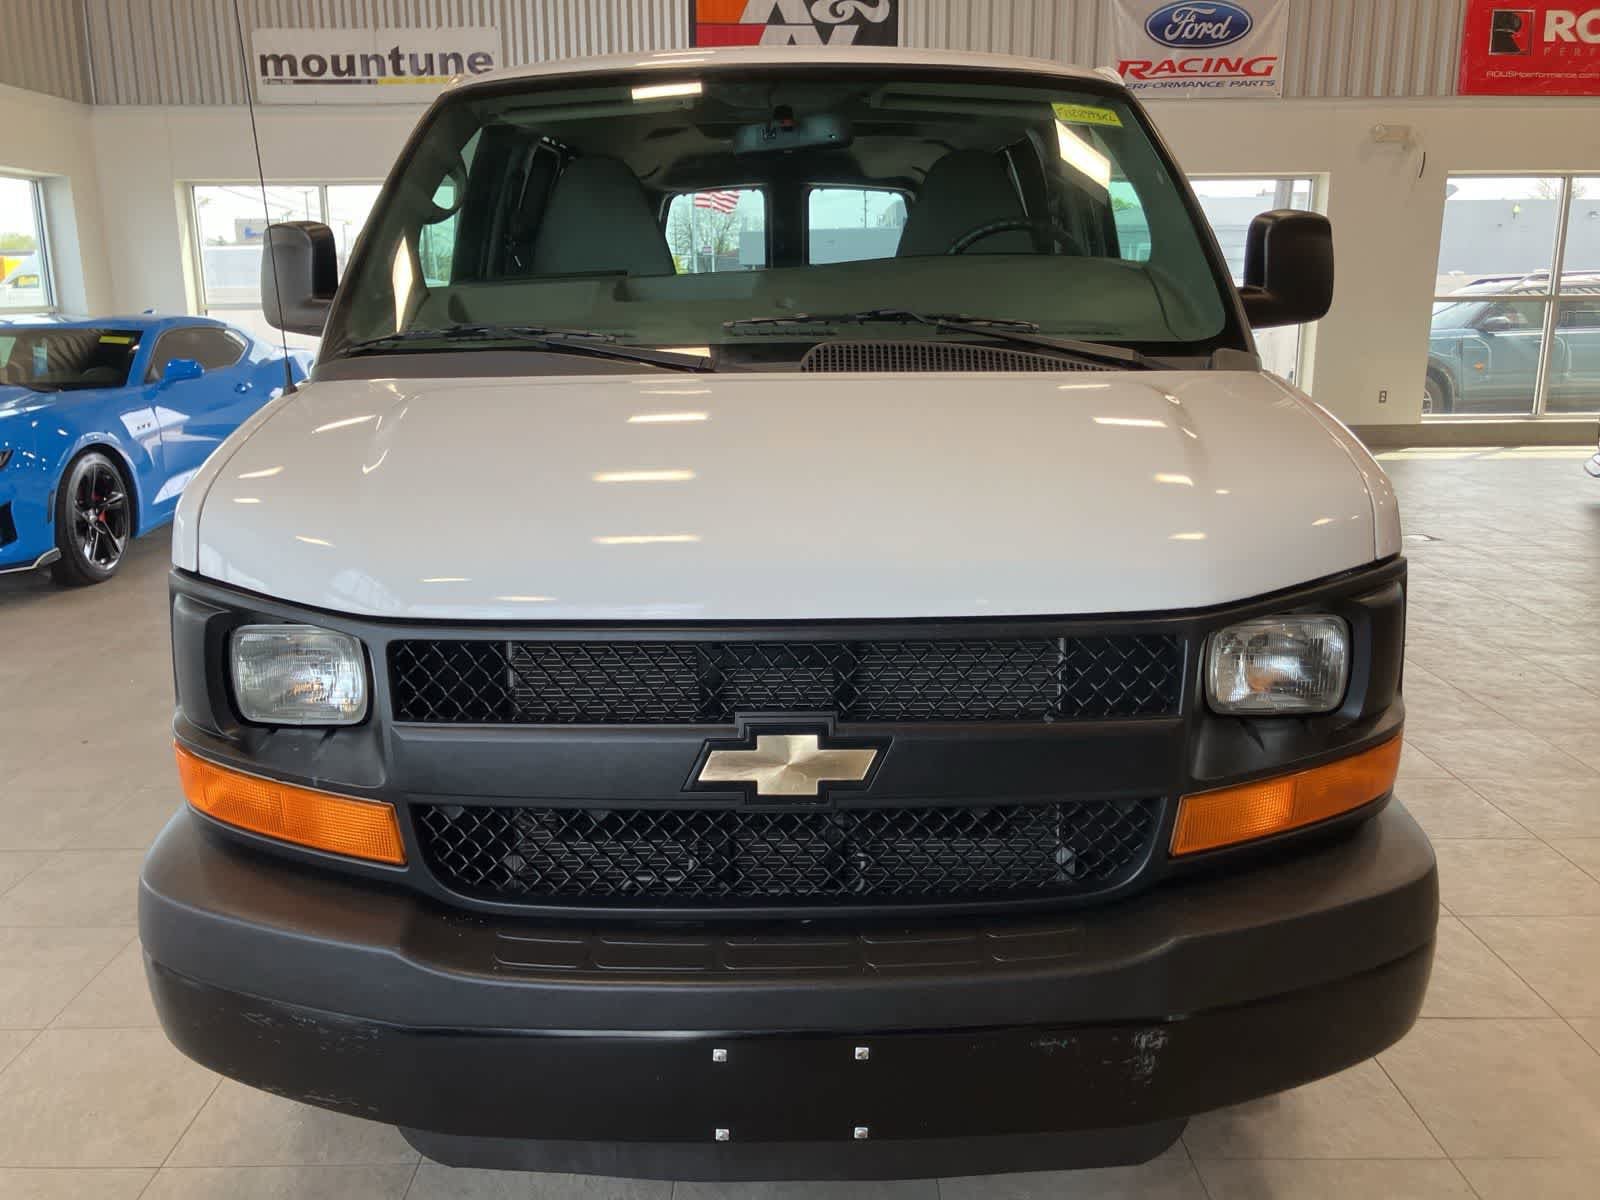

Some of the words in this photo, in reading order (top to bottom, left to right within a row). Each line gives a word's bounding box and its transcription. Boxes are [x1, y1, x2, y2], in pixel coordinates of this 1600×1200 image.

[1164, 6, 1232, 41] Ford
[259, 46, 494, 78] mountune
[1117, 57, 1277, 80] RACING
[1125, 80, 1225, 91] ERFORMANCE
[1229, 79, 1276, 88] PARTS
